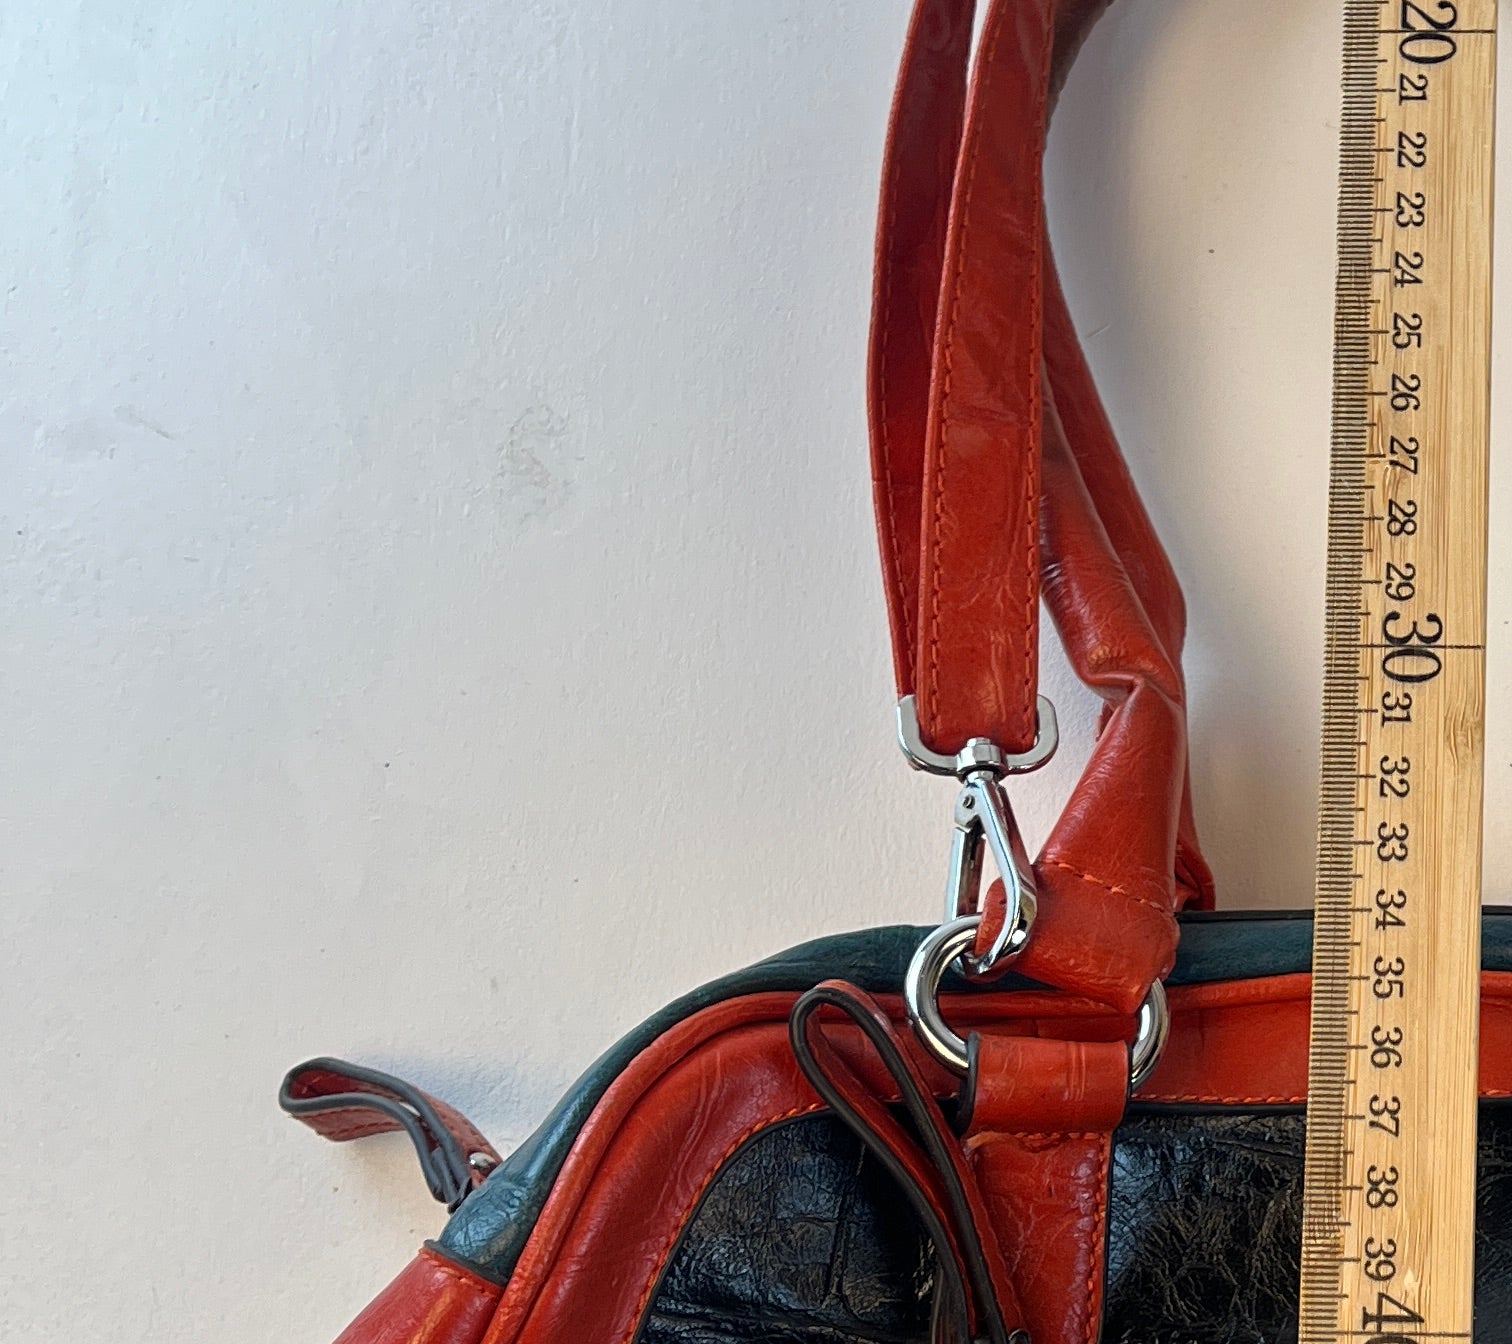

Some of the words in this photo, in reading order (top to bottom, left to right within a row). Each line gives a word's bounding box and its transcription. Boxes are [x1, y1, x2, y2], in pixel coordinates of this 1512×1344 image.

[1399, 0, 1458, 63] 20
[1398, 74, 1428, 105] 21
[1396, 132, 1427, 168] 22
[1395, 192, 1426, 227] 23
[1394, 252, 1424, 288] 24
[1392, 313, 1422, 349] 25
[1390, 374, 1421, 411] 26
[1390, 437, 1418, 475] 27
[1387, 499, 1418, 536] 28
[1385, 562, 1416, 602] 29
[1381, 612, 1444, 684] 30
[1381, 692, 1412, 727] 31
[1379, 756, 1410, 798] 32
[1377, 822, 1409, 862] 33
[1376, 890, 1406, 930] 34
[1373, 956, 1404, 1000] 35
[1371, 1026, 1402, 1068] 36
[1368, 1095, 1400, 1138] 37
[1366, 1166, 1398, 1209] 38
[1364, 1238, 1396, 1282] 39
